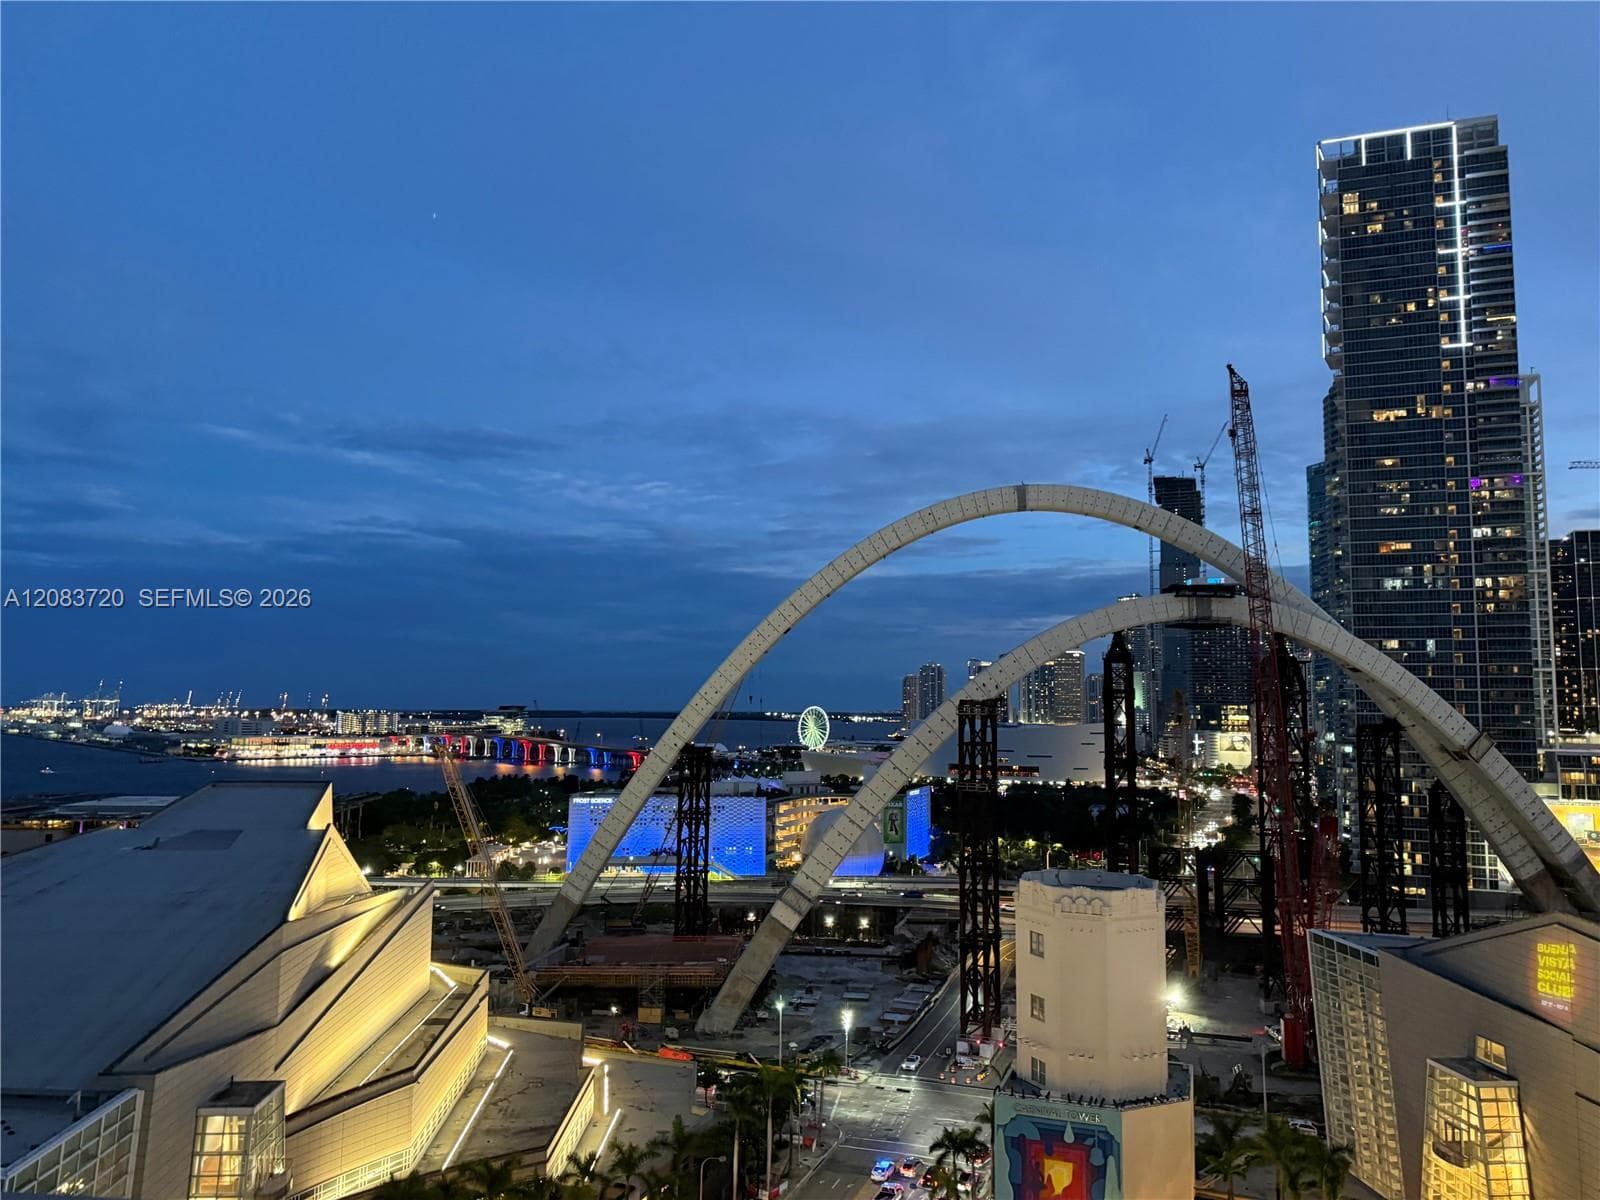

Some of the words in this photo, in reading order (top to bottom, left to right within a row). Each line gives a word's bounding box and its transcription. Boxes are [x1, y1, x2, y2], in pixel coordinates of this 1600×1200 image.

[1537, 943, 1577, 955] BUENA
[1537, 955, 1576, 970] VISTA
[1537, 968, 1575, 983] SOCIAL
[1537, 982, 1575, 998] CLUB
[1065, 1110, 1102, 1123] TOWER
